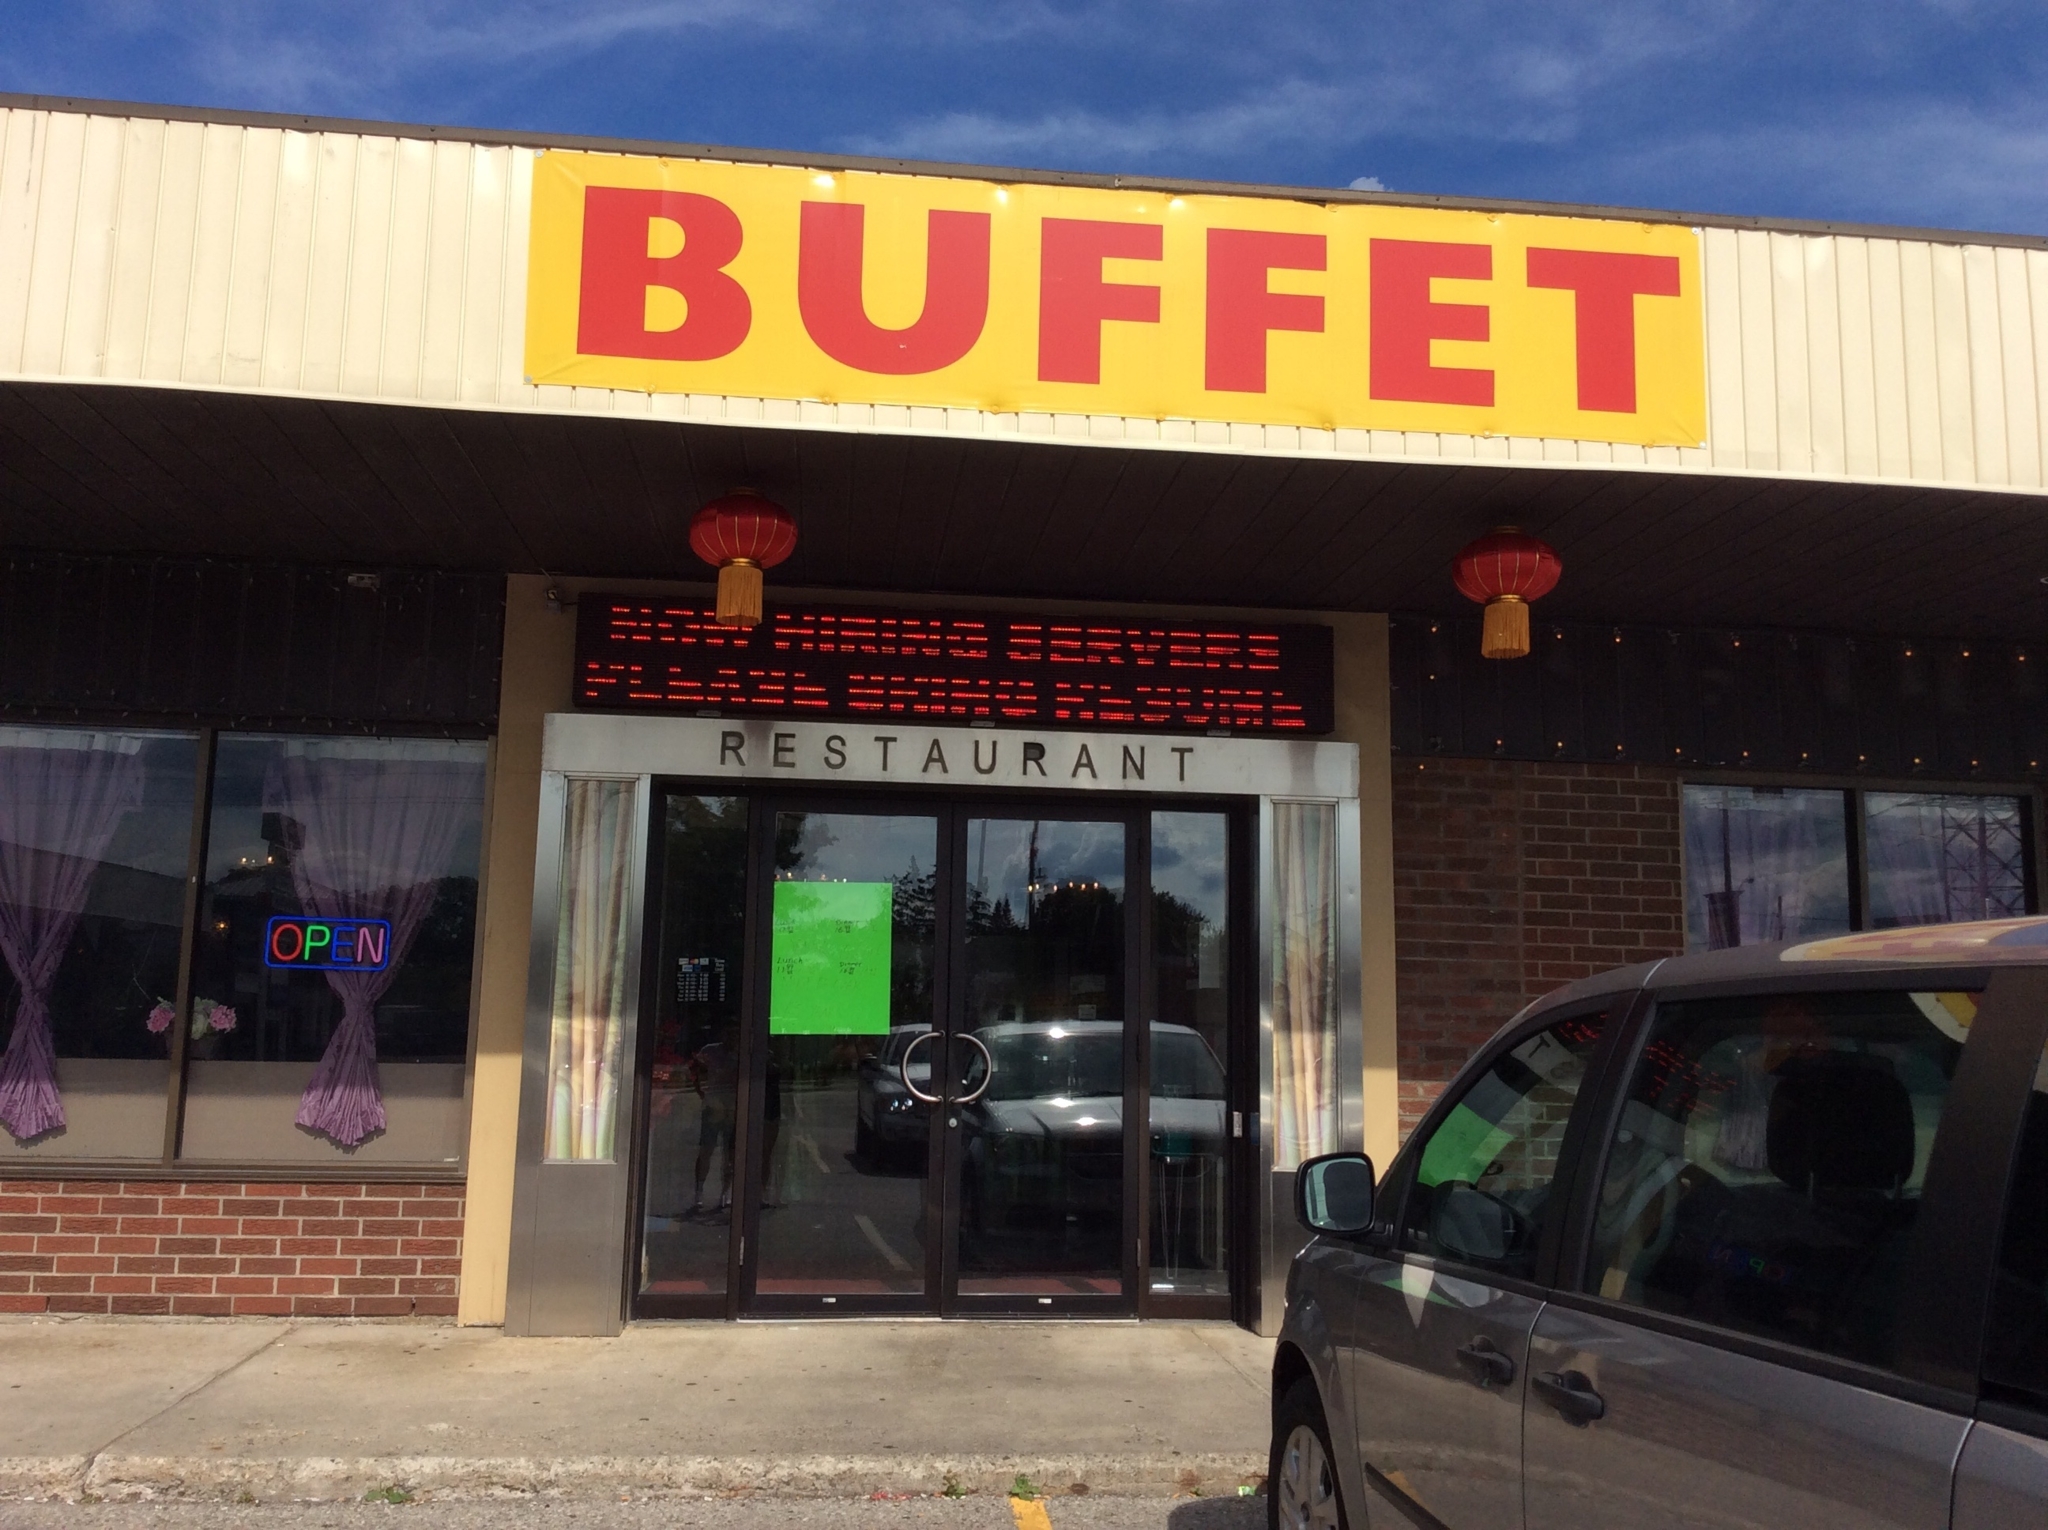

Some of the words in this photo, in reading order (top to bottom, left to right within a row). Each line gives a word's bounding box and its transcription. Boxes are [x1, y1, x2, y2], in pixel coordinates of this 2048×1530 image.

[577, 185, 1680, 413] BUFFET
[775, 614, 987, 658] HIRING
[1008, 624, 1277, 670] SERVERS
[587, 662, 828, 707] PLEASE
[719, 731, 1194, 782] RESTAURANT
[272, 923, 385, 964] OPEN
